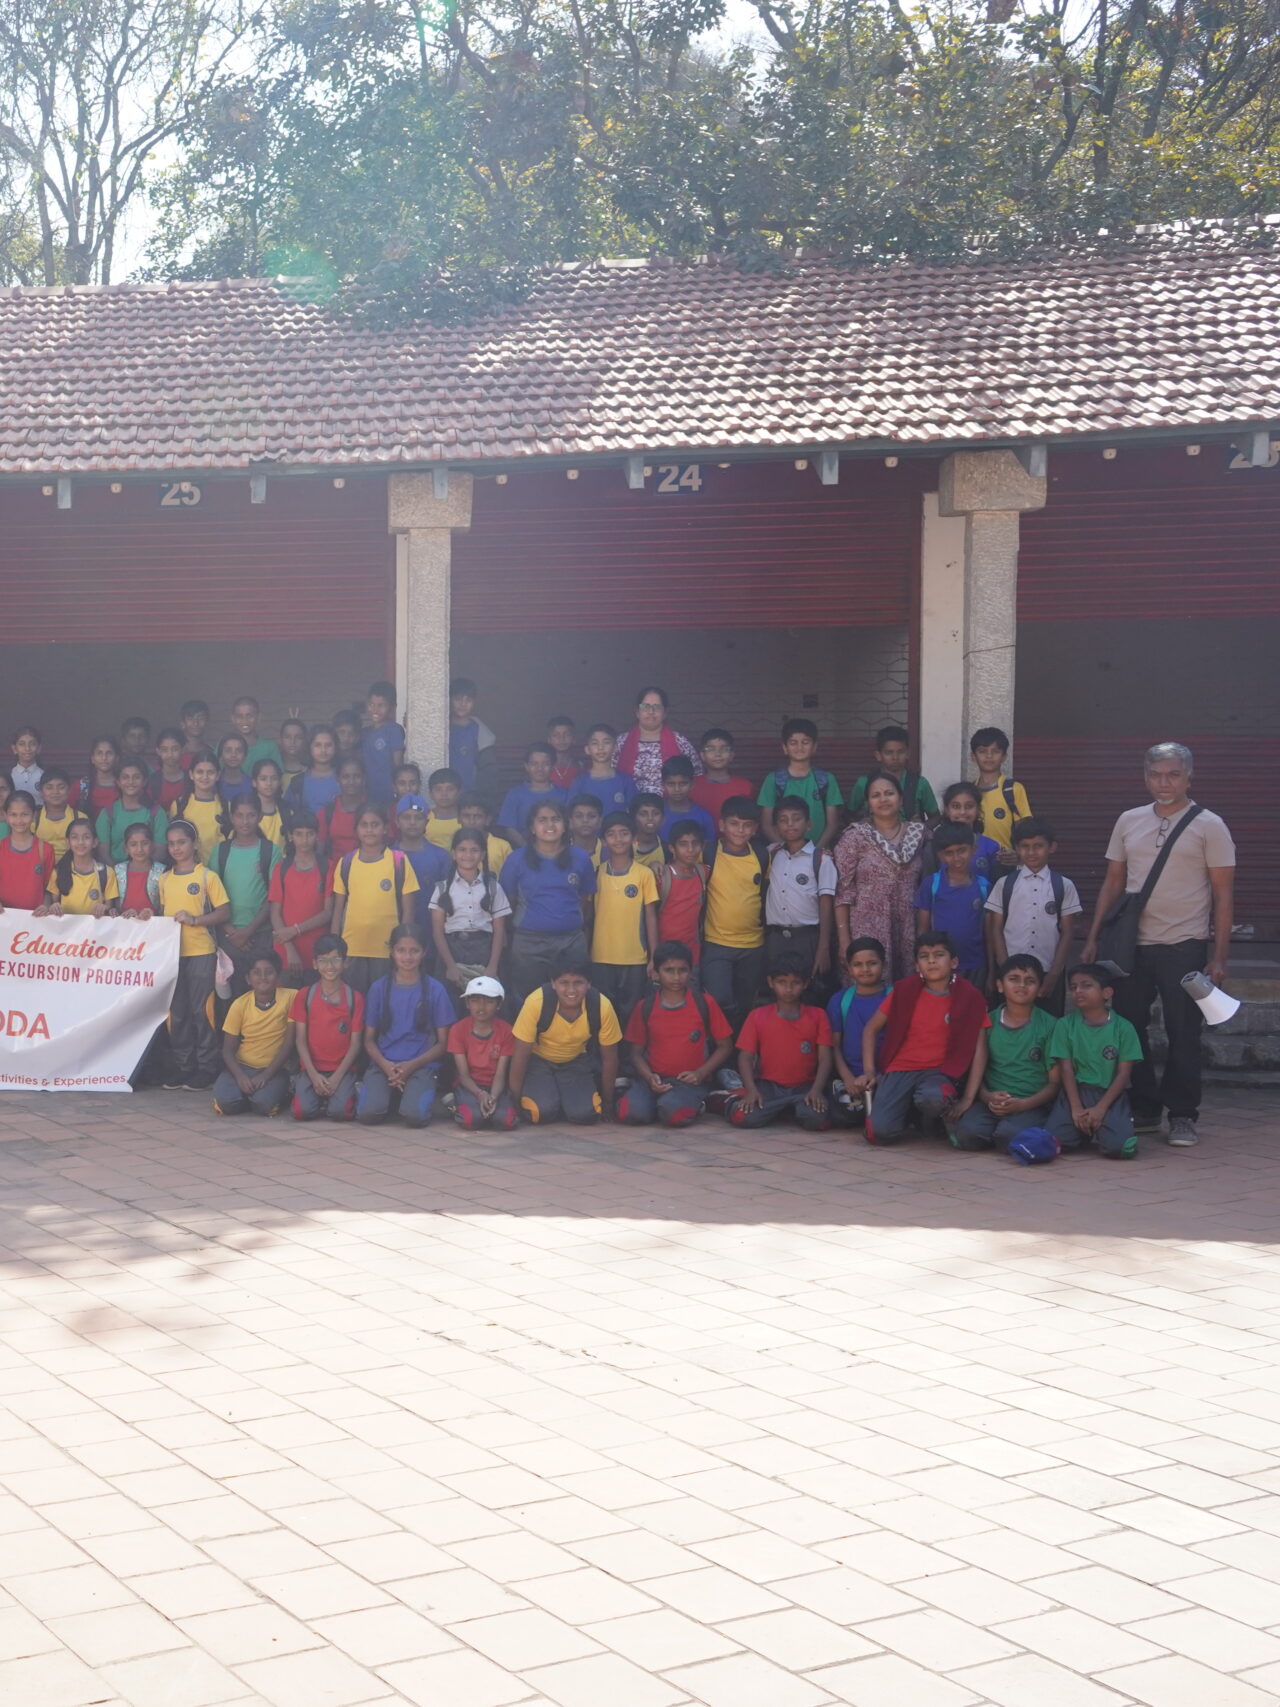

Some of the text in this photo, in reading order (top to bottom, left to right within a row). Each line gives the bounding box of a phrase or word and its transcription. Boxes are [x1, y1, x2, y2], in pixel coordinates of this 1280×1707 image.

[658, 464, 702, 492] 24
[160, 482, 201, 506] 25
[10, 931, 147, 961] Educational
[86, 968, 155, 988] PROGRAM
[41, 1078, 50, 1086] &
